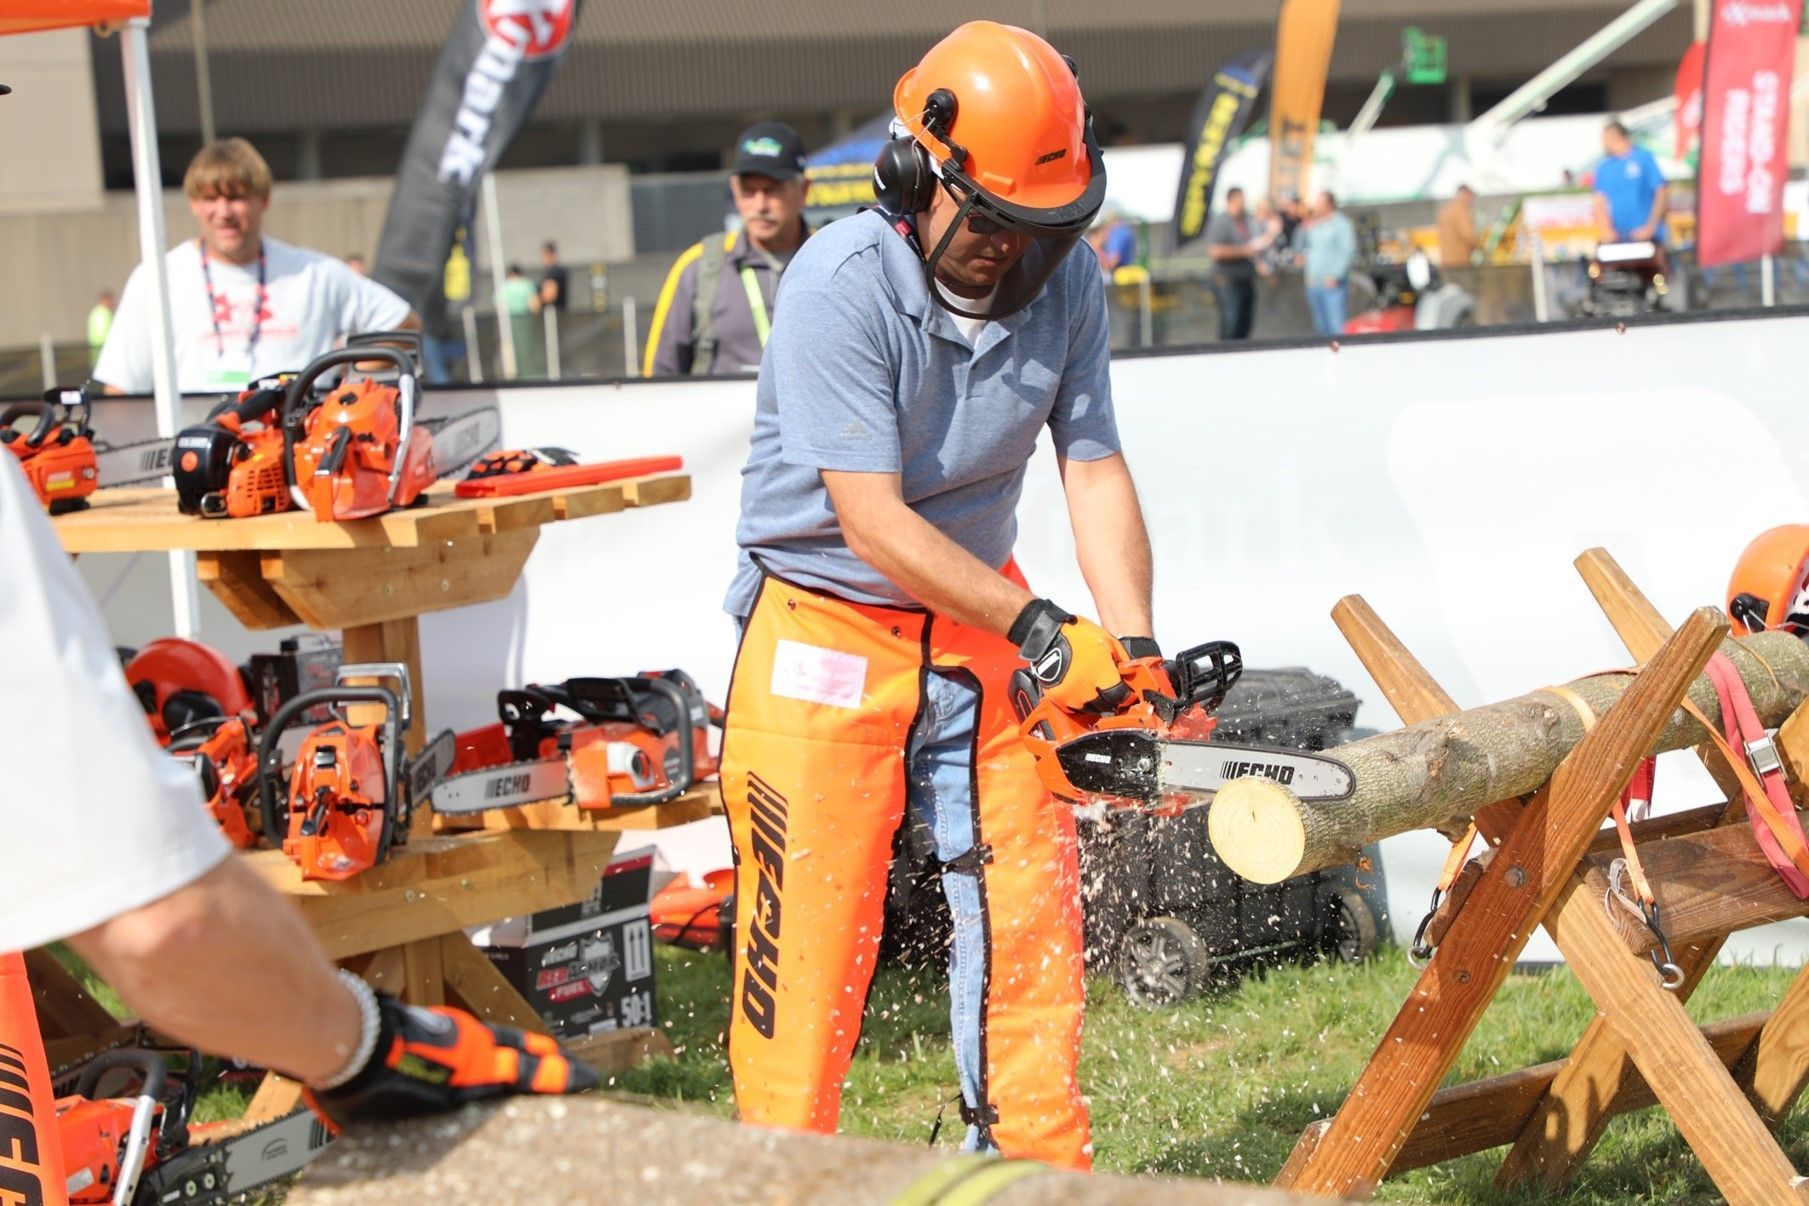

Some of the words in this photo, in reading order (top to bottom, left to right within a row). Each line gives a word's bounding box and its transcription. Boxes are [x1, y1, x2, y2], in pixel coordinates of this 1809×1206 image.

[1037, 148, 1067, 164] ECHO
[1229, 760, 1296, 785] ECHO
[494, 773, 531, 797] ECHO
[741, 812, 786, 1040] ECHO
